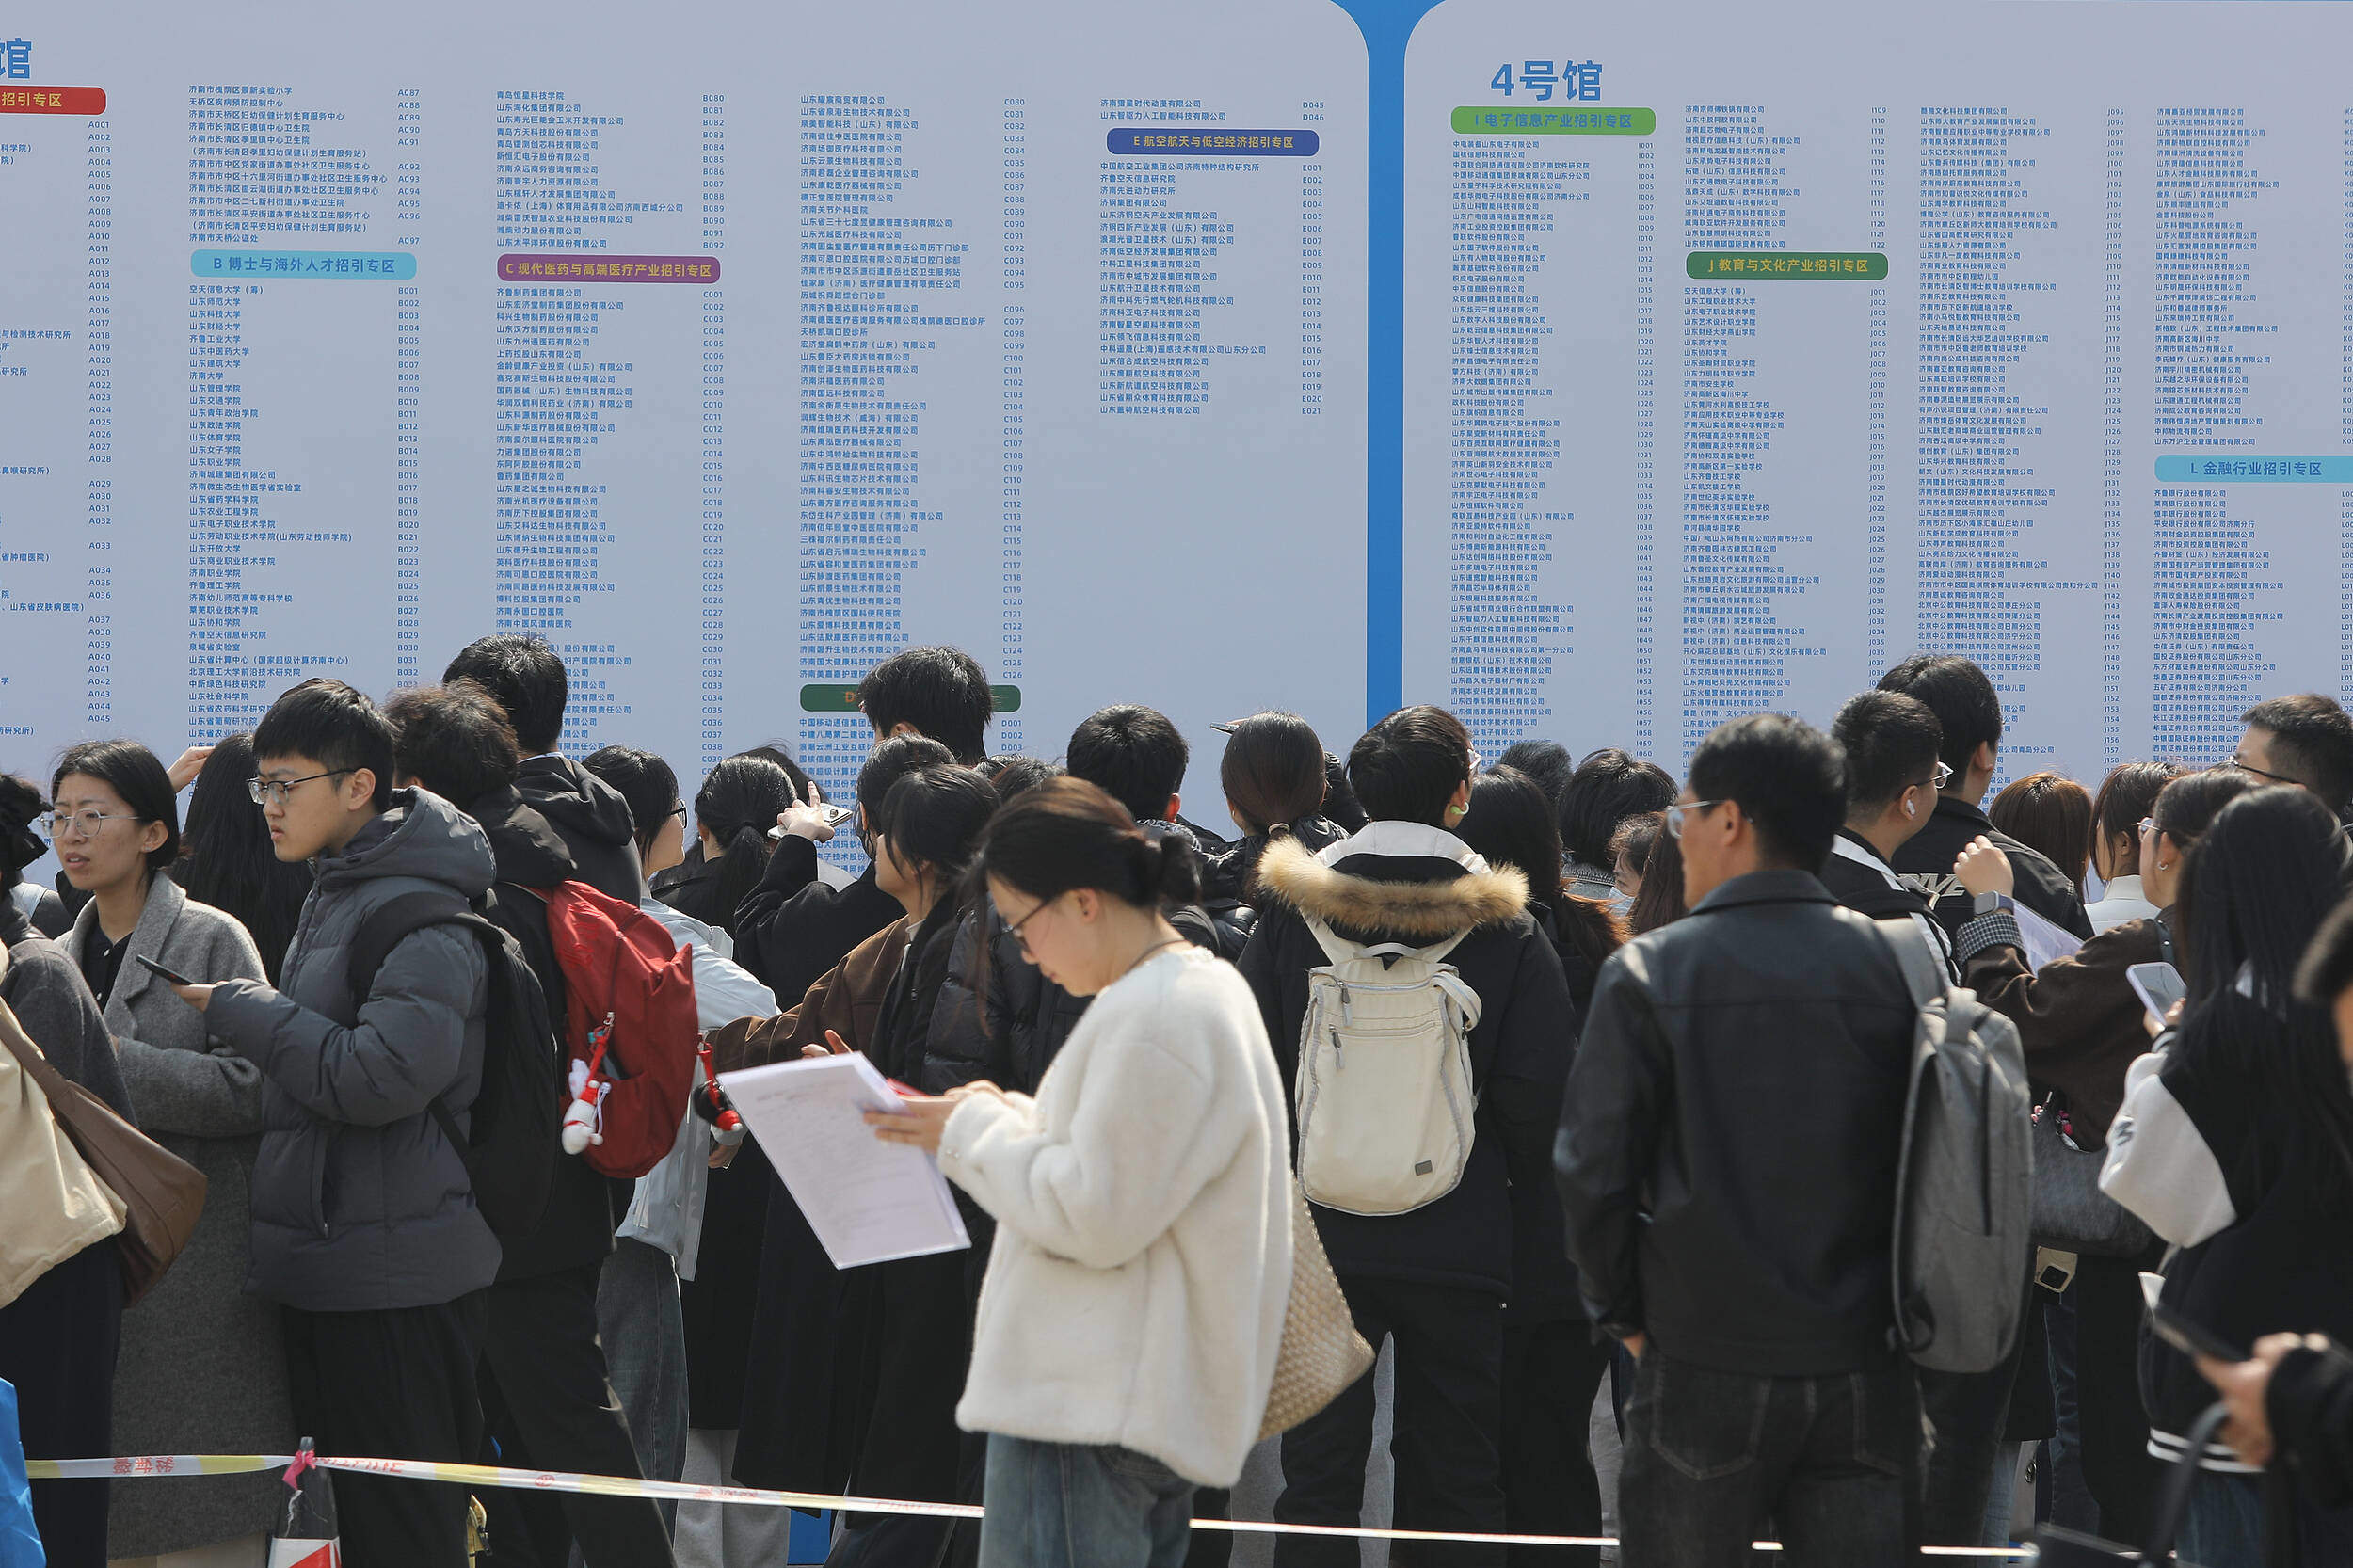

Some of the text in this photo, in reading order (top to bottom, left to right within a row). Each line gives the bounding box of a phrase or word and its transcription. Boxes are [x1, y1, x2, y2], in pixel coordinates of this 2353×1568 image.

[1490, 59, 1604, 102] 4号馆
[1, 92, 62, 108] 招引专区
[1302, 101, 1323, 109] D045
[188, 109, 421, 121] 济南市天桥区妇幼保健计划生育服务中心 A089
[1484, 112, 1633, 129] 电子信息产业招引专区
[702, 131, 724, 139] B083
[2106, 129, 2124, 137] J097
[1133, 136, 1294, 149] E 航空航天与低空经济招引专区
[88, 145, 112, 154] A003
[397, 174, 421, 184] A093
[1302, 188, 1323, 197] E003
[88, 195, 111, 203] A007
[188, 196, 347, 208] 济南市市中区二七新村街道办事处卫生院
[702, 216, 725, 225] B090
[188, 232, 259, 243] 济南市天桥公证处
[2106, 232, 2122, 241] J107
[88, 257, 111, 265] A012
[213, 257, 395, 275] B 博士与海外人才招引专区
[1708, 258, 1869, 273] J 教育与文化产业招引专区
[505, 263, 712, 279] C 现代医药与高端医疗产业招引专区
[189, 296, 241, 307] 山东师范大学
[1003, 305, 1025, 313] C096
[189, 309, 241, 320] 山东科技大学
[88, 319, 110, 328] A017
[189, 321, 420, 332] 山东财经大学 B004
[1869, 319, 1887, 328] J004
[0, 329, 72, 340] 与检测技术研究所
[702, 327, 724, 336] C004
[188, 333, 242, 344] 齐鲁工业大学
[1302, 334, 1321, 343] E015
[189, 345, 250, 357] 山东中医药大学
[189, 359, 241, 369] 山东建筑大学
[2105, 356, 2121, 364] J119
[189, 371, 224, 381] 济南大学
[88, 380, 112, 390] A022
[189, 383, 242, 393] 山东管理学院
[1003, 403, 1024, 411] C104
[1302, 407, 1321, 415] E021
[189, 408, 259, 419] 山东青年政治学院
[397, 422, 420, 431] B012
[702, 424, 724, 434] C012
[1868, 421, 1885, 431] J014
[88, 430, 112, 439] A026
[189, 444, 242, 456] 山东女子学院
[2190, 460, 2323, 477] L 金融行业招引专区
[2104, 489, 2121, 498] J132
[88, 504, 110, 513] A031
[1002, 512, 1022, 520] C113
[189, 519, 420, 530] 山东电子职业技术学院 B020
[702, 523, 724, 532] C020
[1868, 536, 1885, 544] J025
[188, 568, 242, 579] 济南职业学院
[188, 579, 242, 590] 齐鲁理工学院
[702, 584, 724, 593] C025
[397, 606, 419, 616] B027
[1002, 610, 1021, 618] C121
[88, 616, 111, 626] A037
[189, 617, 241, 628] 山东协和学院
[2104, 623, 2121, 632] J145
[188, 630, 267, 640] 齐鲁空天信息研究院
[1002, 659, 1023, 667] C125
[188, 678, 266, 689] 中新绿色科技研究院
[701, 681, 723, 690] C033
[188, 691, 249, 701] 山东社会科学院
[845, 691, 856, 703] D
[88, 702, 111, 711] A044
[2103, 715, 2120, 724] J154
[701, 730, 722, 739] C037
[1000, 731, 1024, 740] D002
